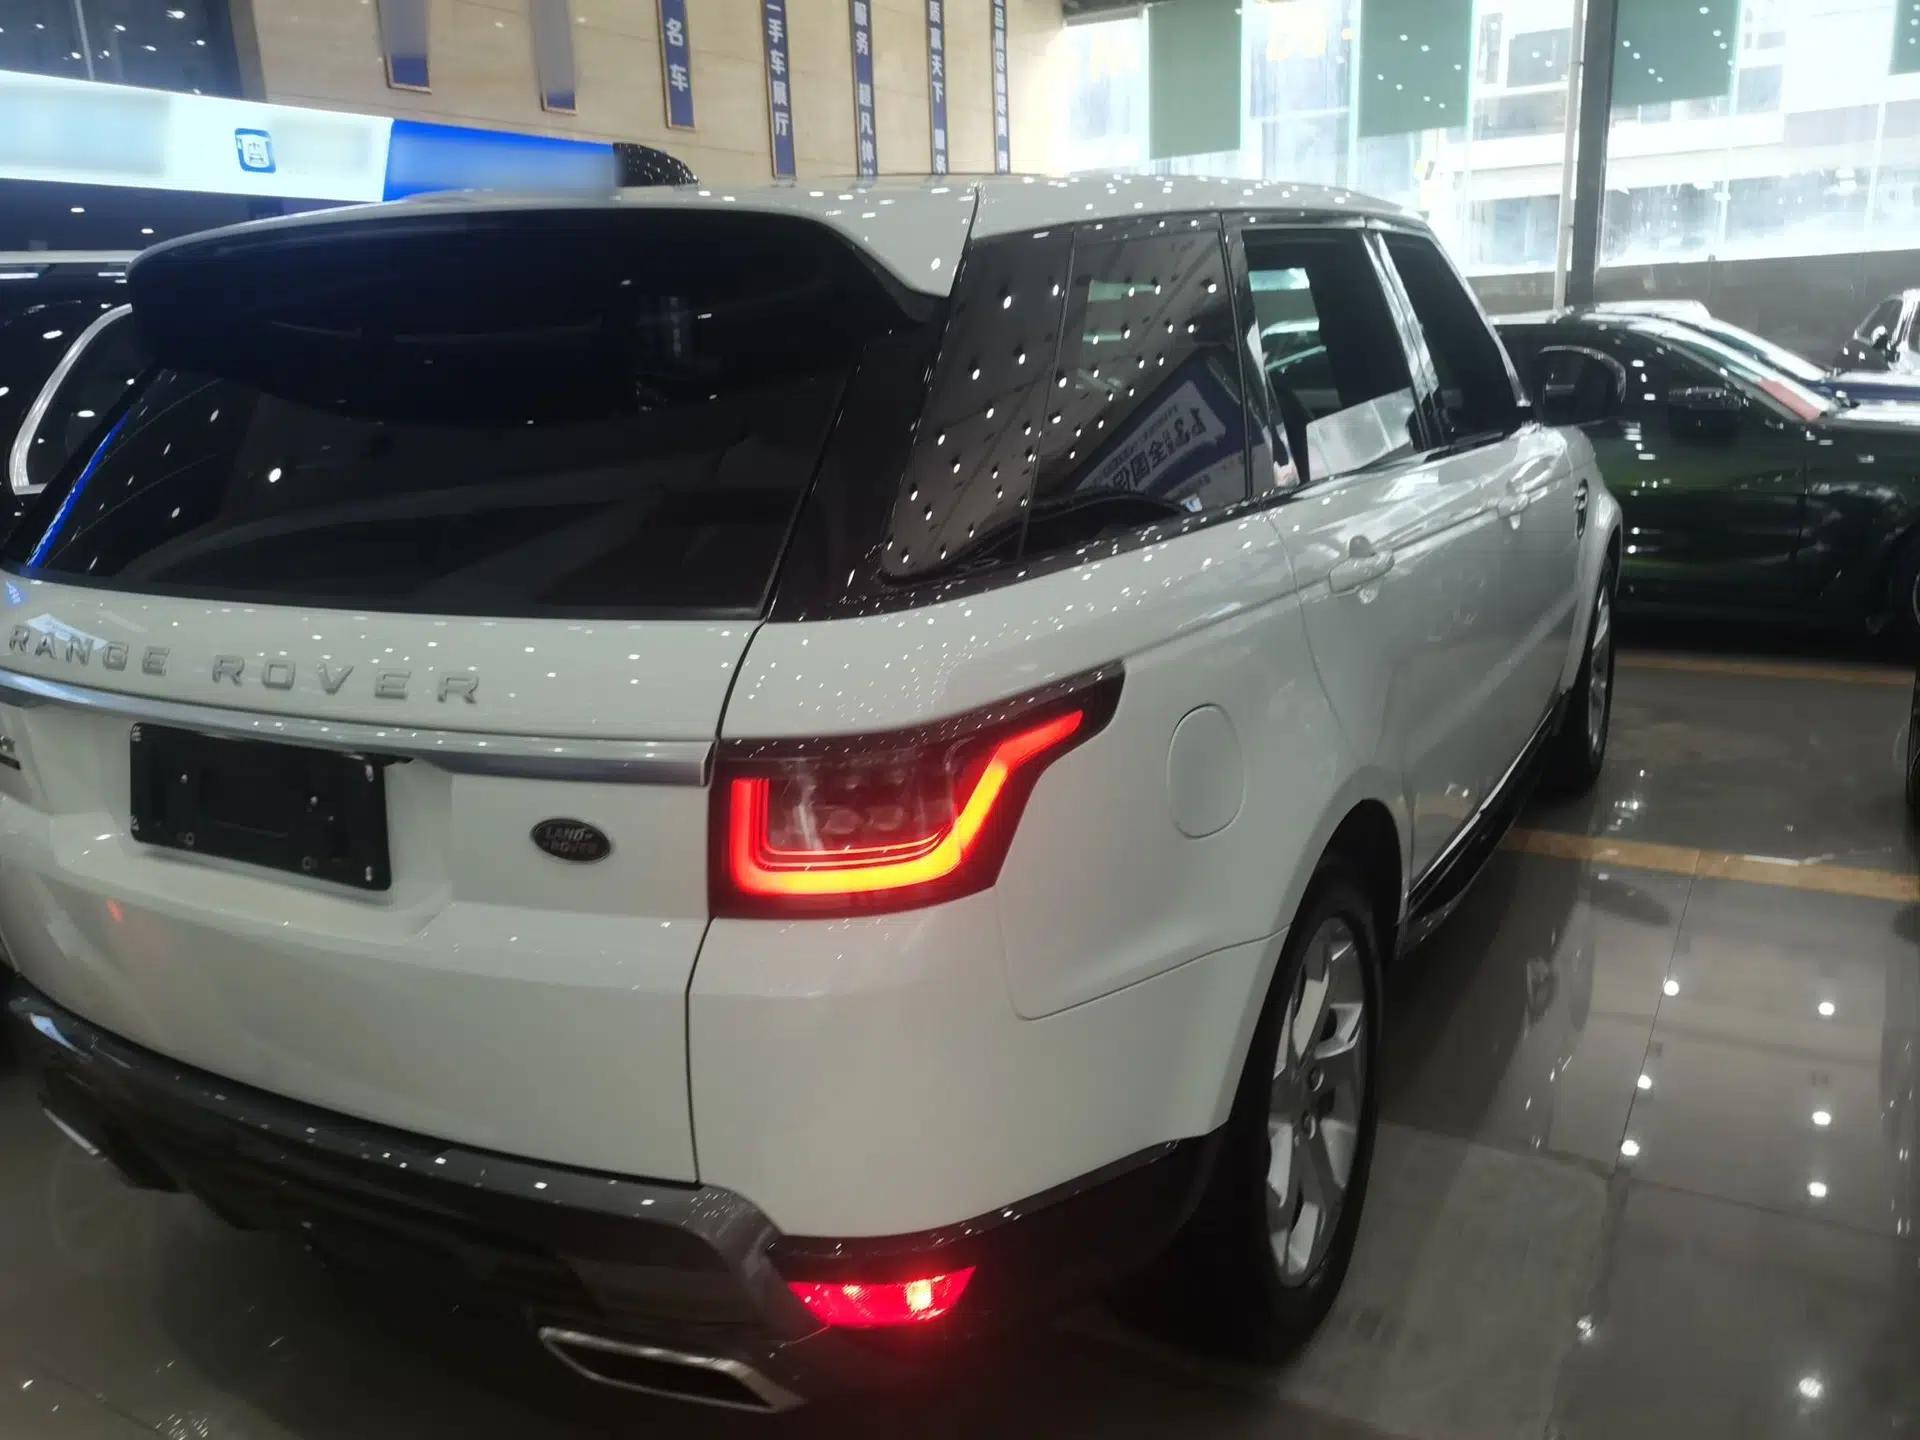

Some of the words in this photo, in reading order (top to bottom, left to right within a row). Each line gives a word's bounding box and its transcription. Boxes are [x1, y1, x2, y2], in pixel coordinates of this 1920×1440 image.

[666, 18, 689, 92] 名车
[9, 624, 170, 676] RANGE
[211, 653, 479, 704] ROVER
